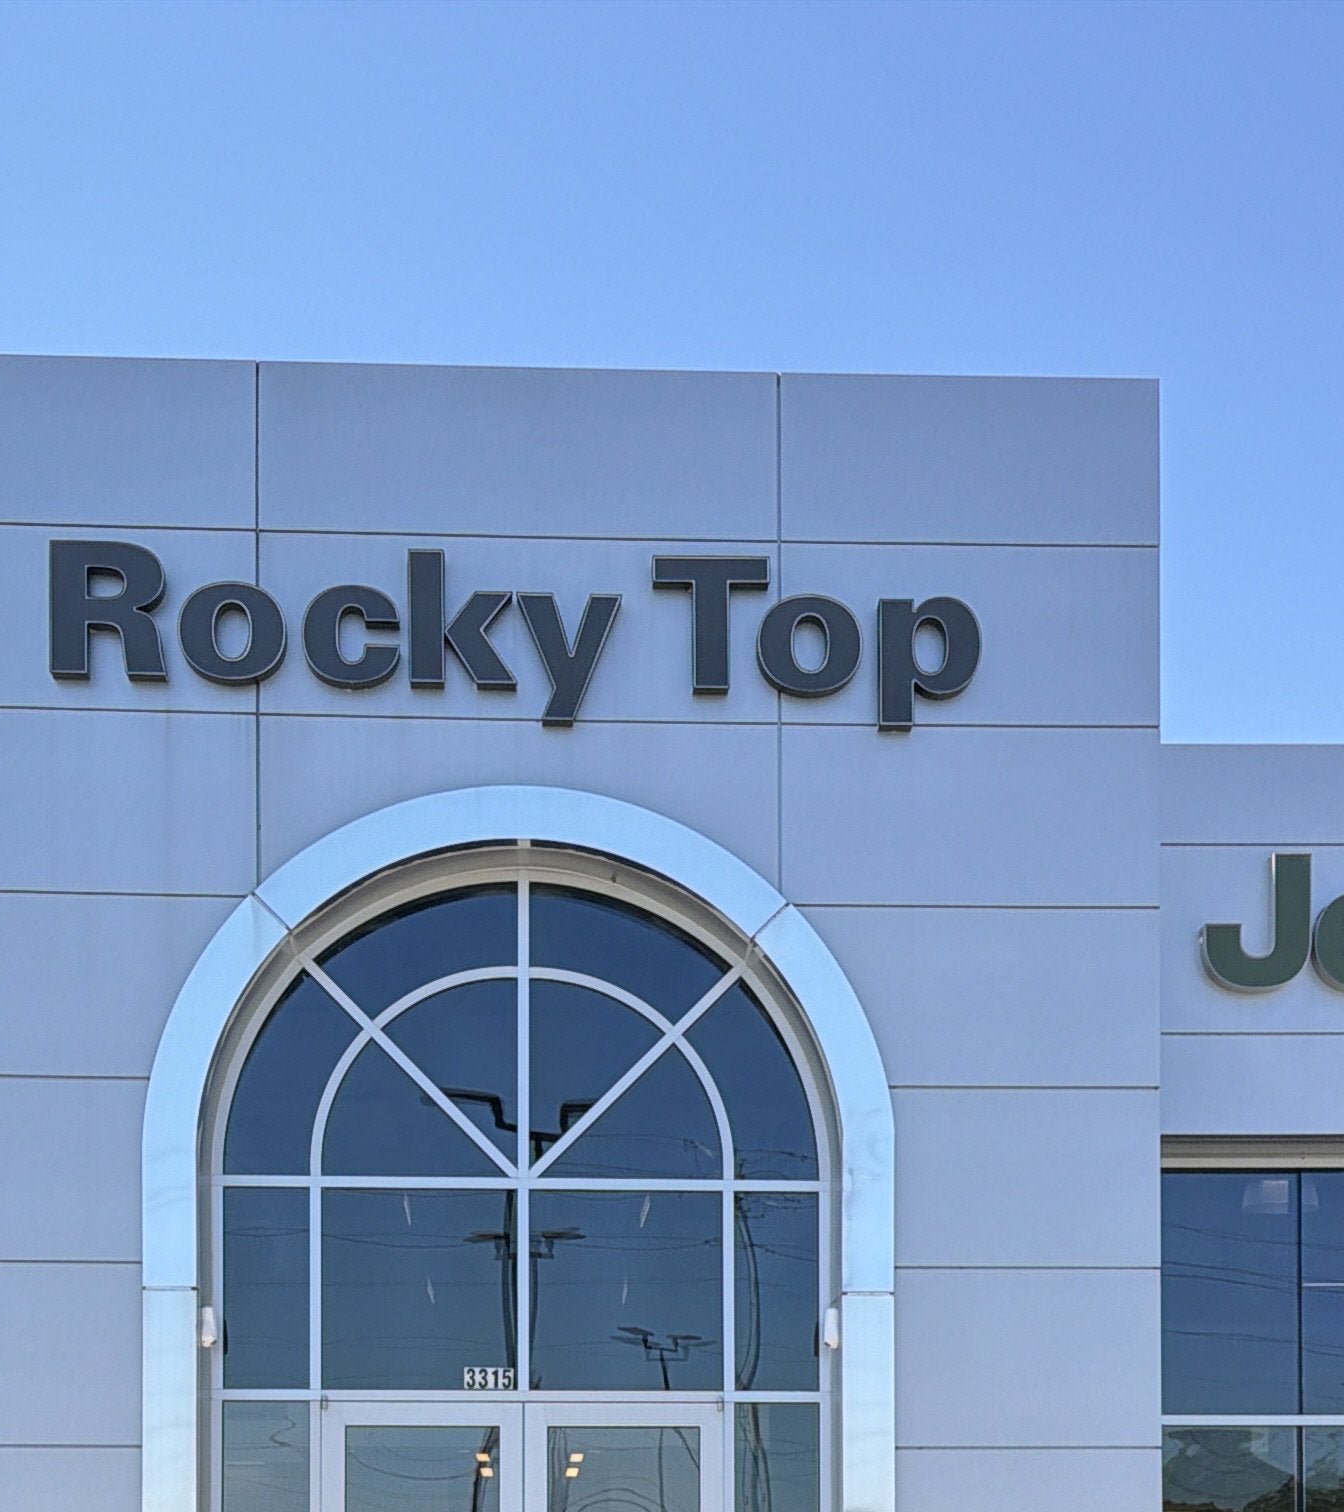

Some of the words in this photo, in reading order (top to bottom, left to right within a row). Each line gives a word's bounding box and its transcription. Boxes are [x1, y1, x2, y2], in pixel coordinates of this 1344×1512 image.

[48, 538, 622, 728] Rocky
[651, 554, 983, 733] Top
[466, 1368, 513, 1389] 3315
